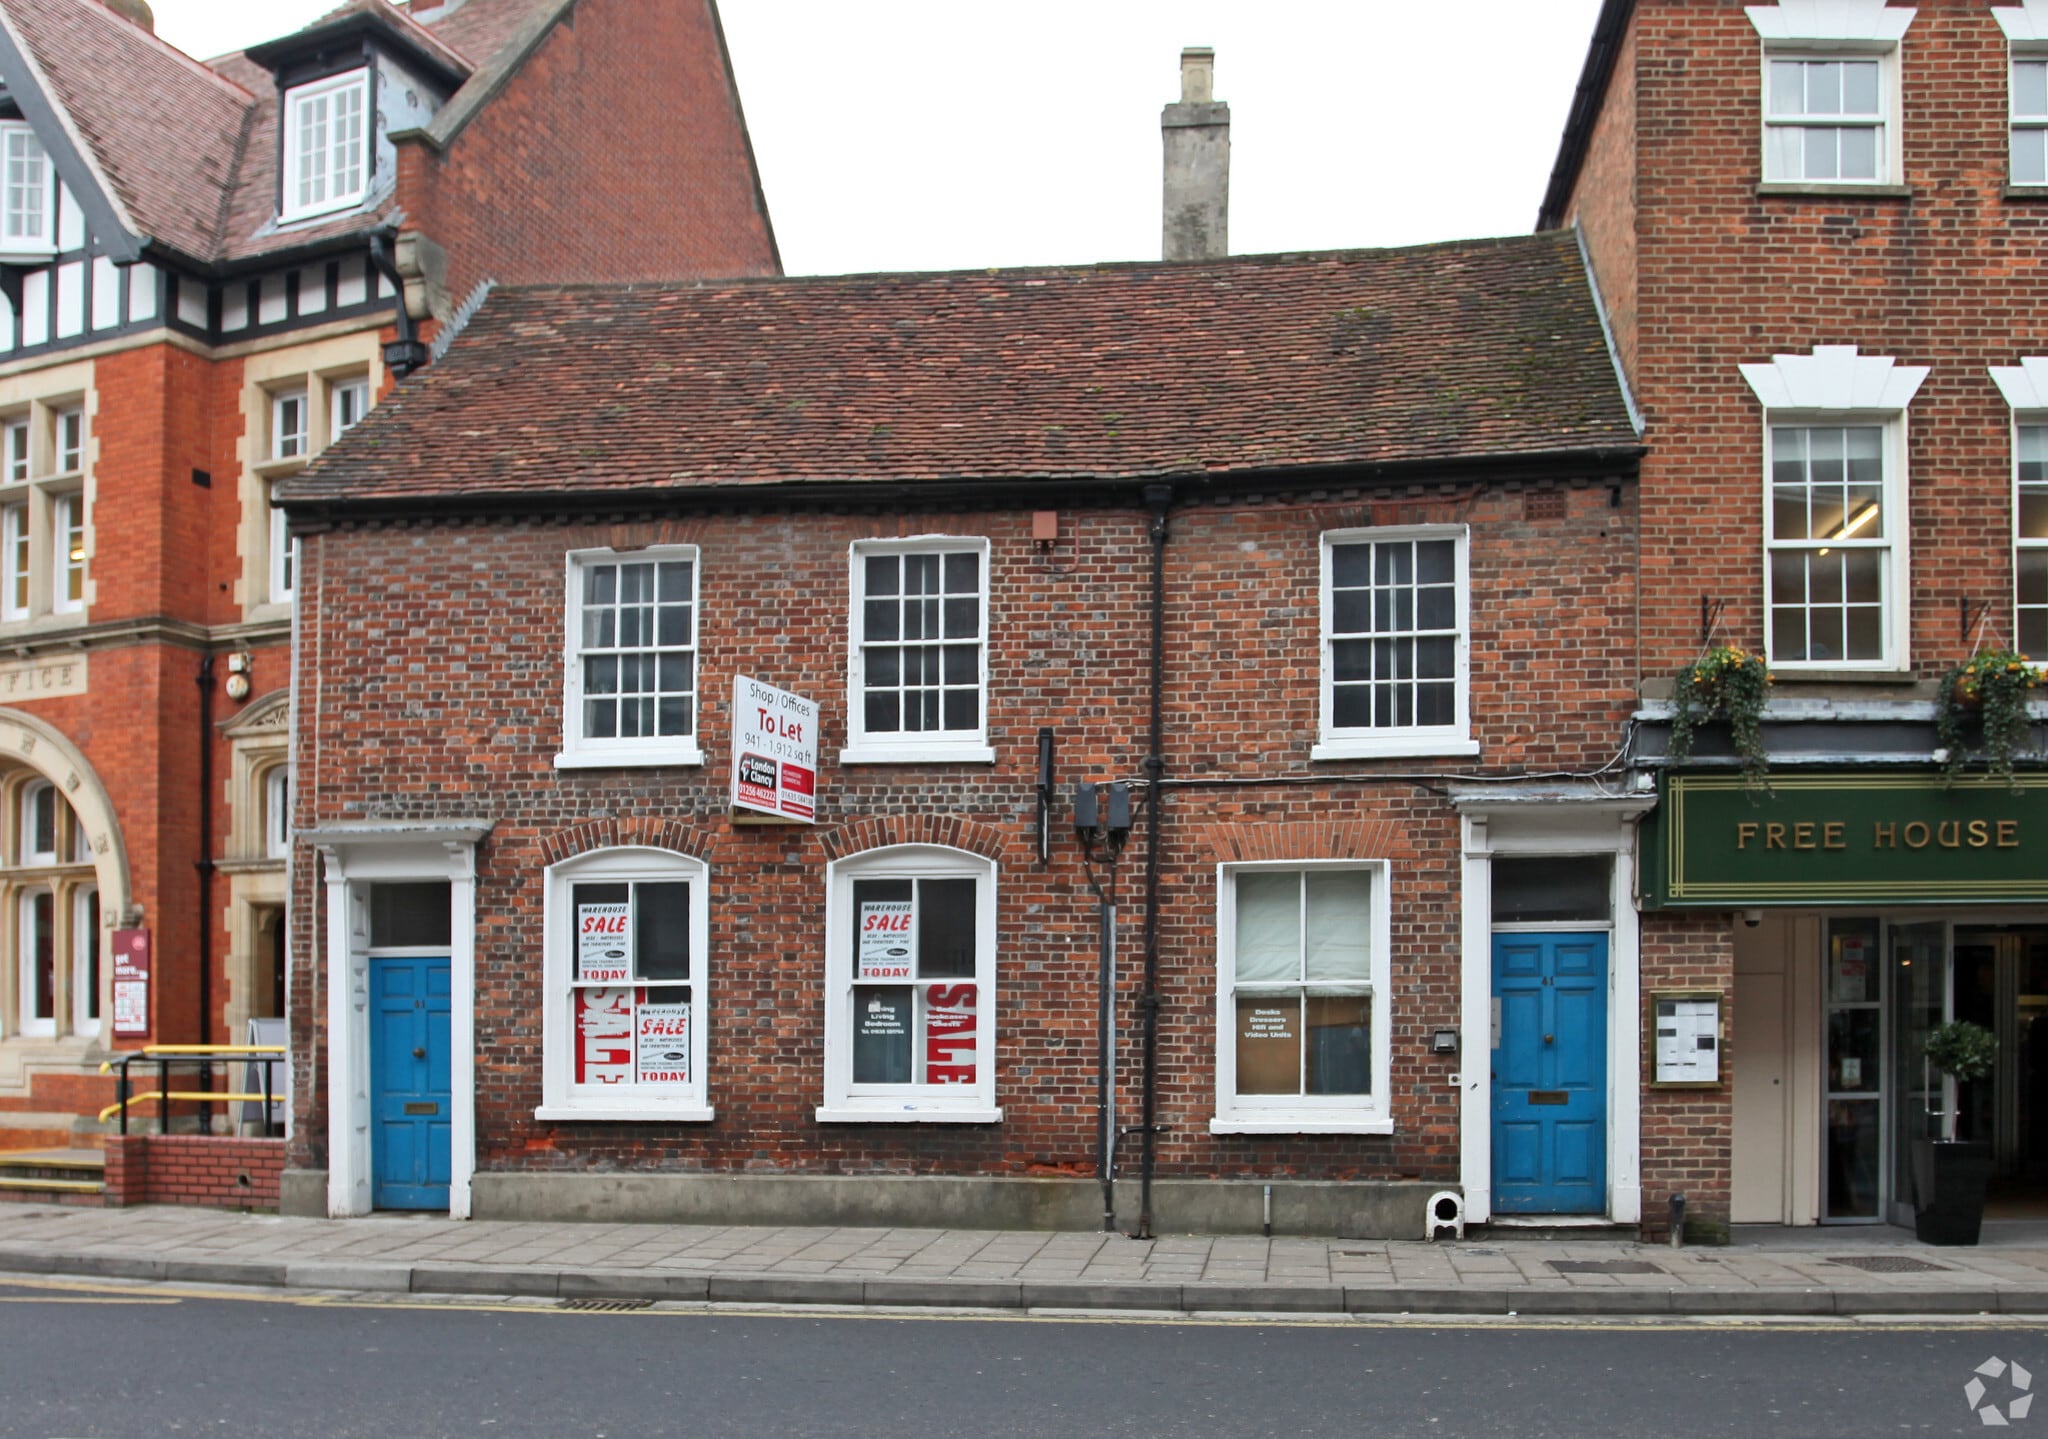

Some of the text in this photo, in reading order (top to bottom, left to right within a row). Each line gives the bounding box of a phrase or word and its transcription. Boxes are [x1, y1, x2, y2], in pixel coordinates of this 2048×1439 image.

[750, 683, 773, 706] Shop
[781, 694, 810, 716] Offices
[758, 707, 802, 743] To Let
[745, 732, 760, 748] 941
[770, 740, 792, 758] 1,912
[794, 750, 803, 764] sq
[805, 750, 811, 763] ft
[751, 758, 775, 775] London
[751, 770, 772, 788] Clancy
[1737, 820, 2020, 849] FREE HOUSE
[582, 916, 627, 933] SALE
[863, 914, 912, 931] SALE
[583, 970, 626, 980] TODAY
[863, 968, 909, 976] TODAY
[640, 1018, 686, 1035] SALE
[927, 984, 976, 1084] SALE
[642, 1072, 685, 1081] TODAY
